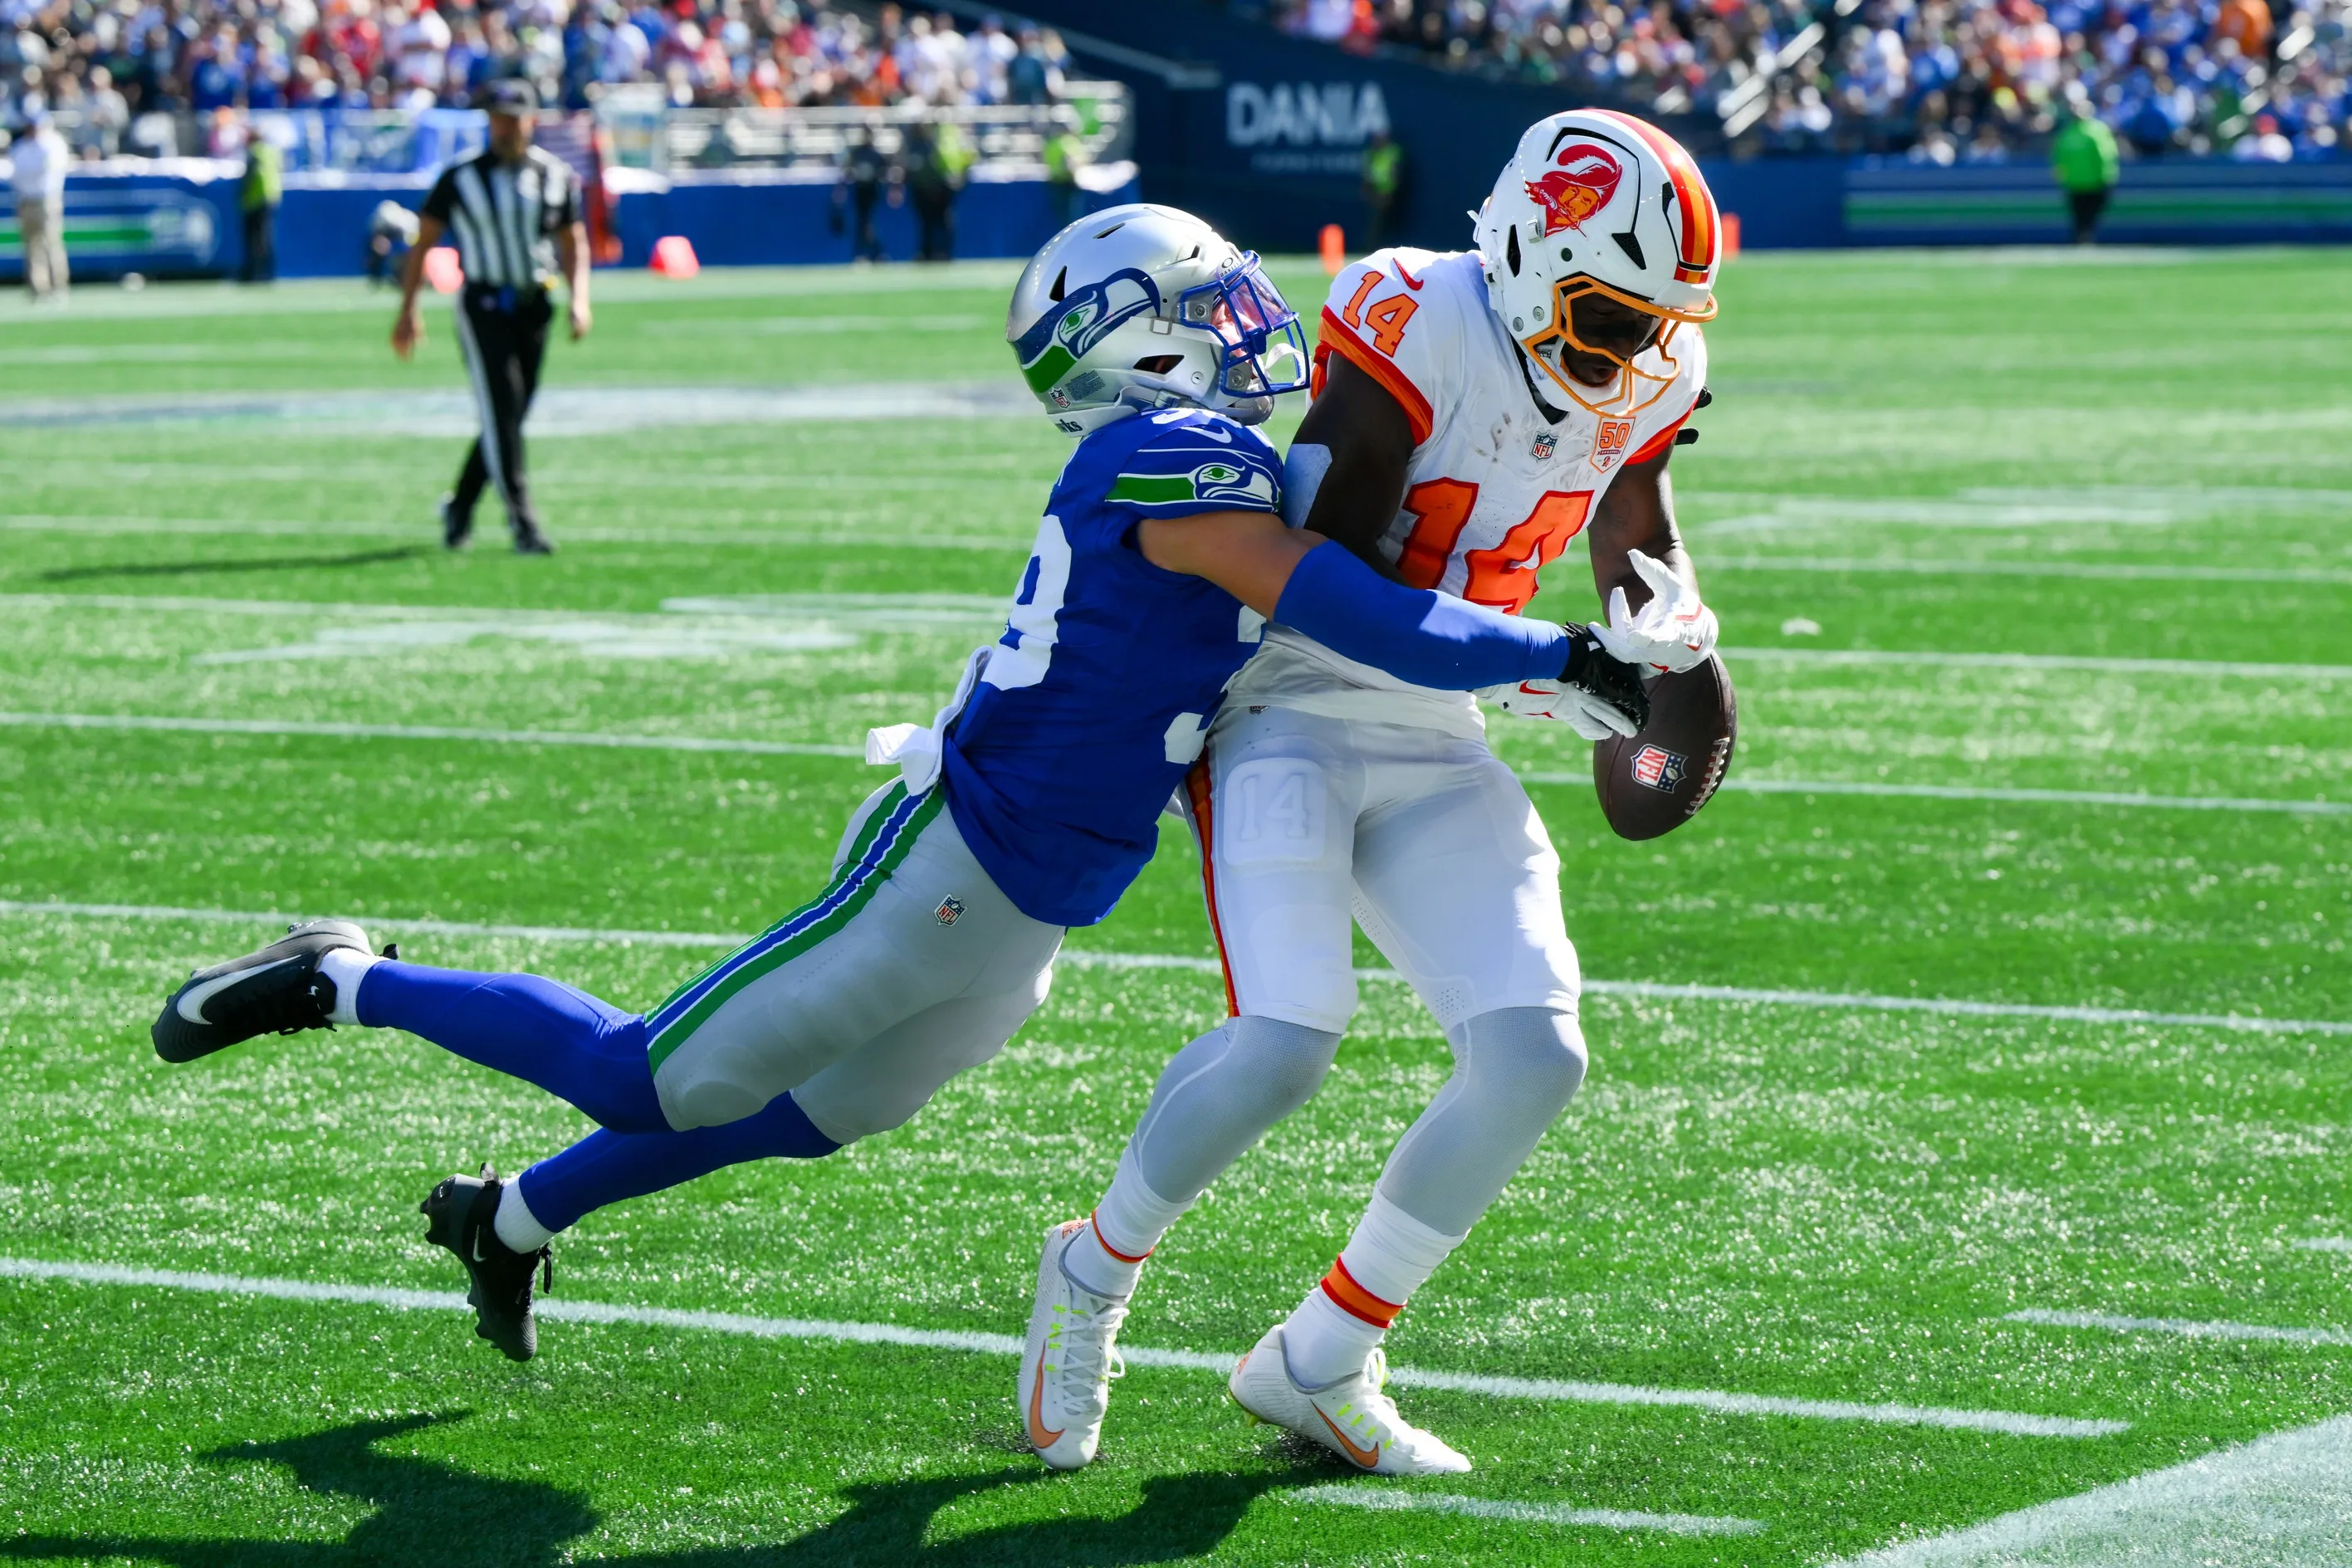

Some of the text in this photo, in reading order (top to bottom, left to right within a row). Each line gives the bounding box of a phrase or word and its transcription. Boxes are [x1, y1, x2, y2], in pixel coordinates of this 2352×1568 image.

[1227, 81, 1391, 146] DANIA
[1342, 271, 1420, 359] 14
[1533, 443, 1552, 457] NFL
[1599, 422, 1631, 449] 50
[1396, 476, 1595, 616] 14
[1637, 748, 1668, 782] NFL
[1240, 772, 1312, 842] 14
[938, 906, 956, 923] NFL
